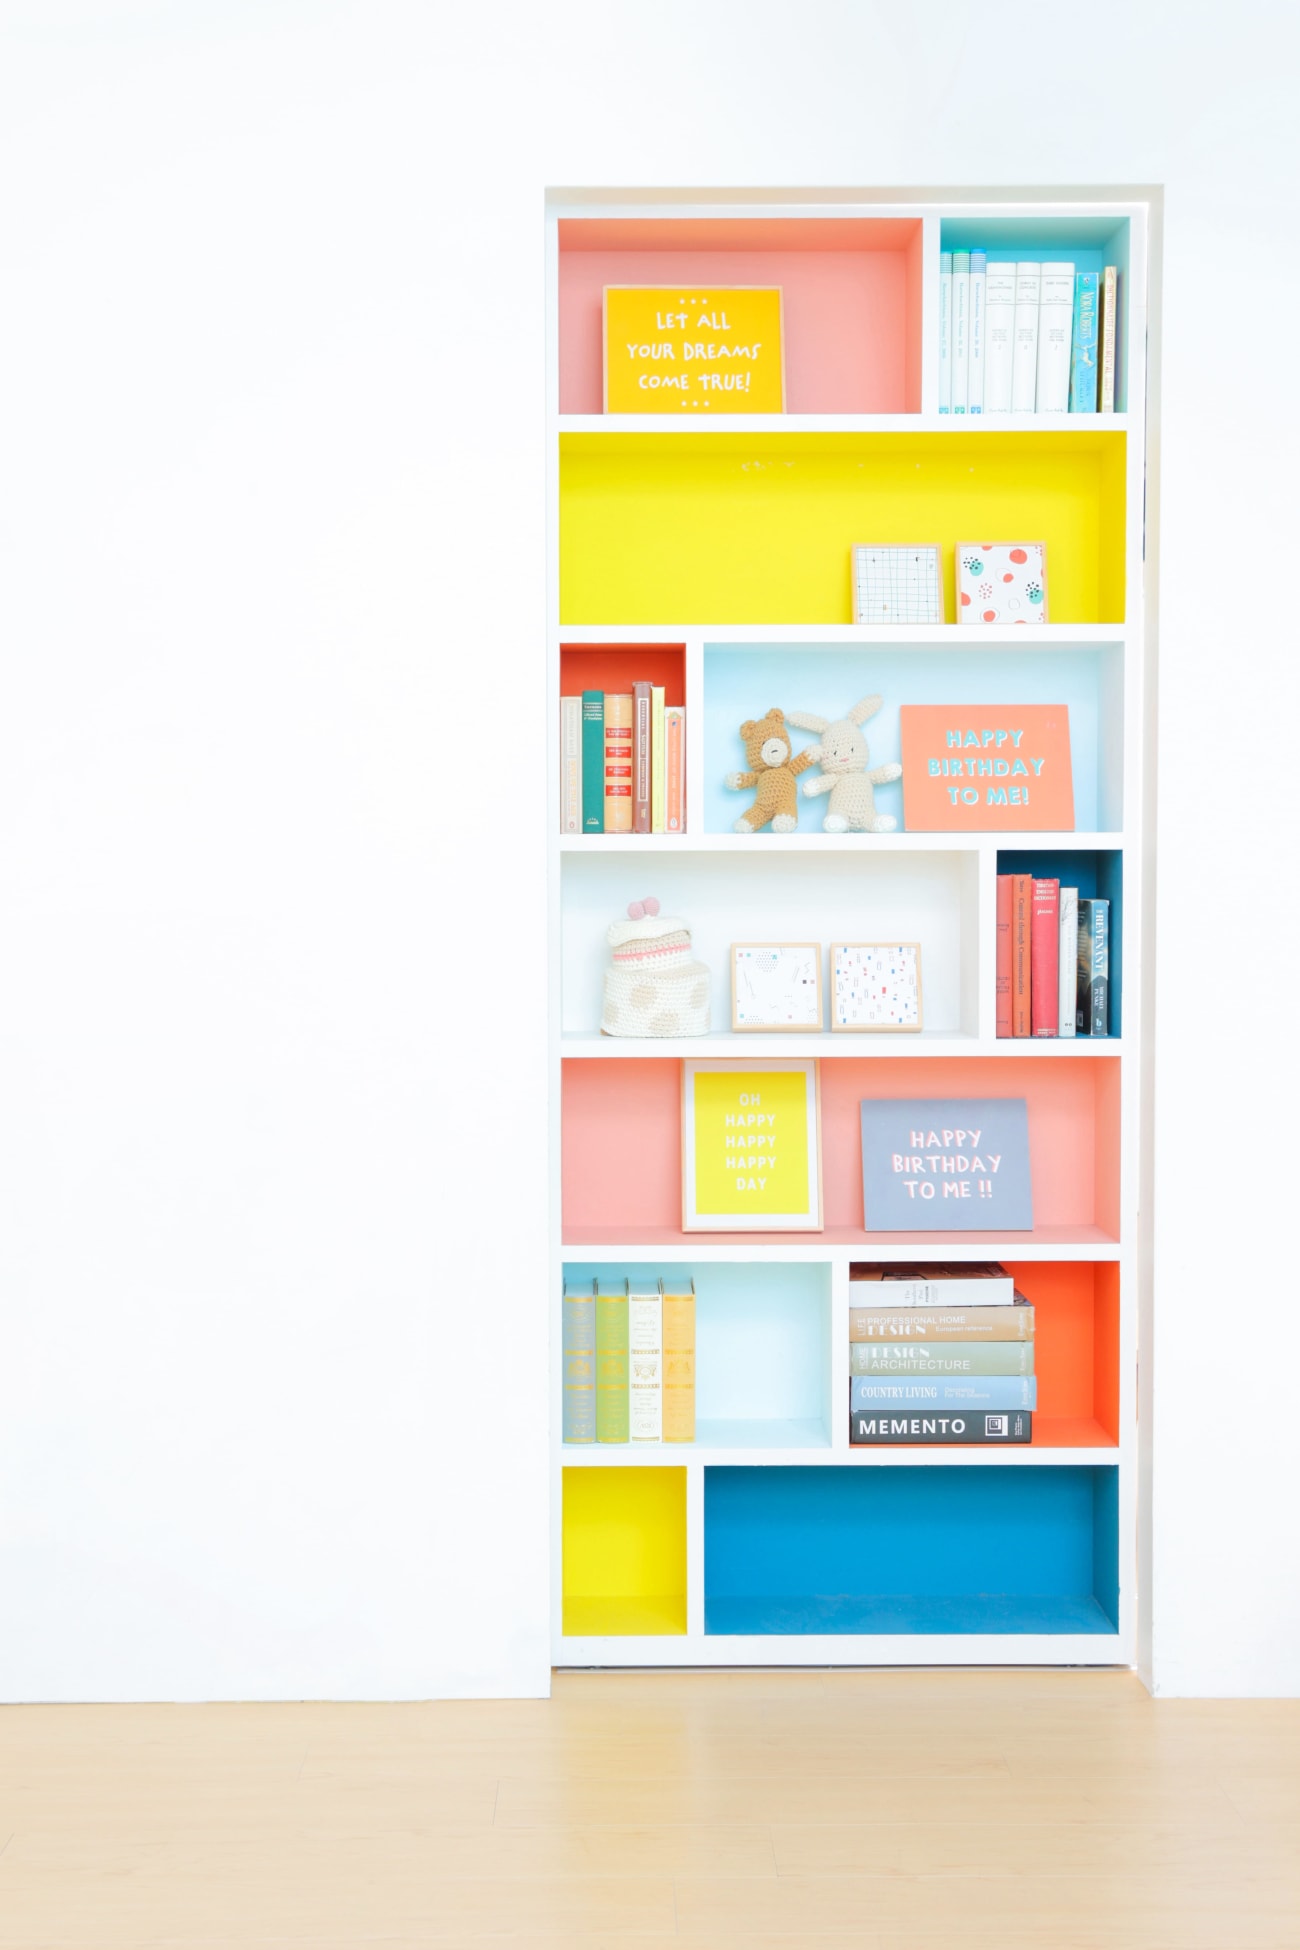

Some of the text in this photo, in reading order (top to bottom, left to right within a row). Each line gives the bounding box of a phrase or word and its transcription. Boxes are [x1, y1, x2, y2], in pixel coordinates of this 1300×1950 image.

[656, 311, 731, 330] LET ALL
[1079, 291, 1094, 340] NORA ROBERTS
[626, 341, 762, 361] YOUR DREAMS
[638, 371, 751, 393] COME TRUE!
[945, 729, 1024, 748] HAPPY
[927, 757, 1045, 777] BIRTHDAY
[946, 786, 1029, 806] TO ME!
[1095, 915, 1105, 969] REVENANT
[739, 1093, 761, 1106] OH
[725, 1114, 776, 1128] HAPPY
[725, 1135, 777, 1148] HAPPY
[909, 1128, 982, 1149] HAPPY
[726, 1156, 777, 1169] HAPPY
[892, 1153, 1002, 1173] BIRTHDAY
[736, 1177, 767, 1191] DAY
[902, 1180, 936, 1199] TO
[942, 1180, 972, 1199] ME
[867, 1315, 966, 1326] PROFESSIONAL HOME
[868, 1325, 927, 1337] DESIGN
[871, 1347, 930, 1359] DESIGN
[871, 1359, 971, 1370] ARCHITECTURE
[860, 1386, 938, 1399] COUNTRY LIVING
[859, 1419, 966, 1435] MEMENTO
